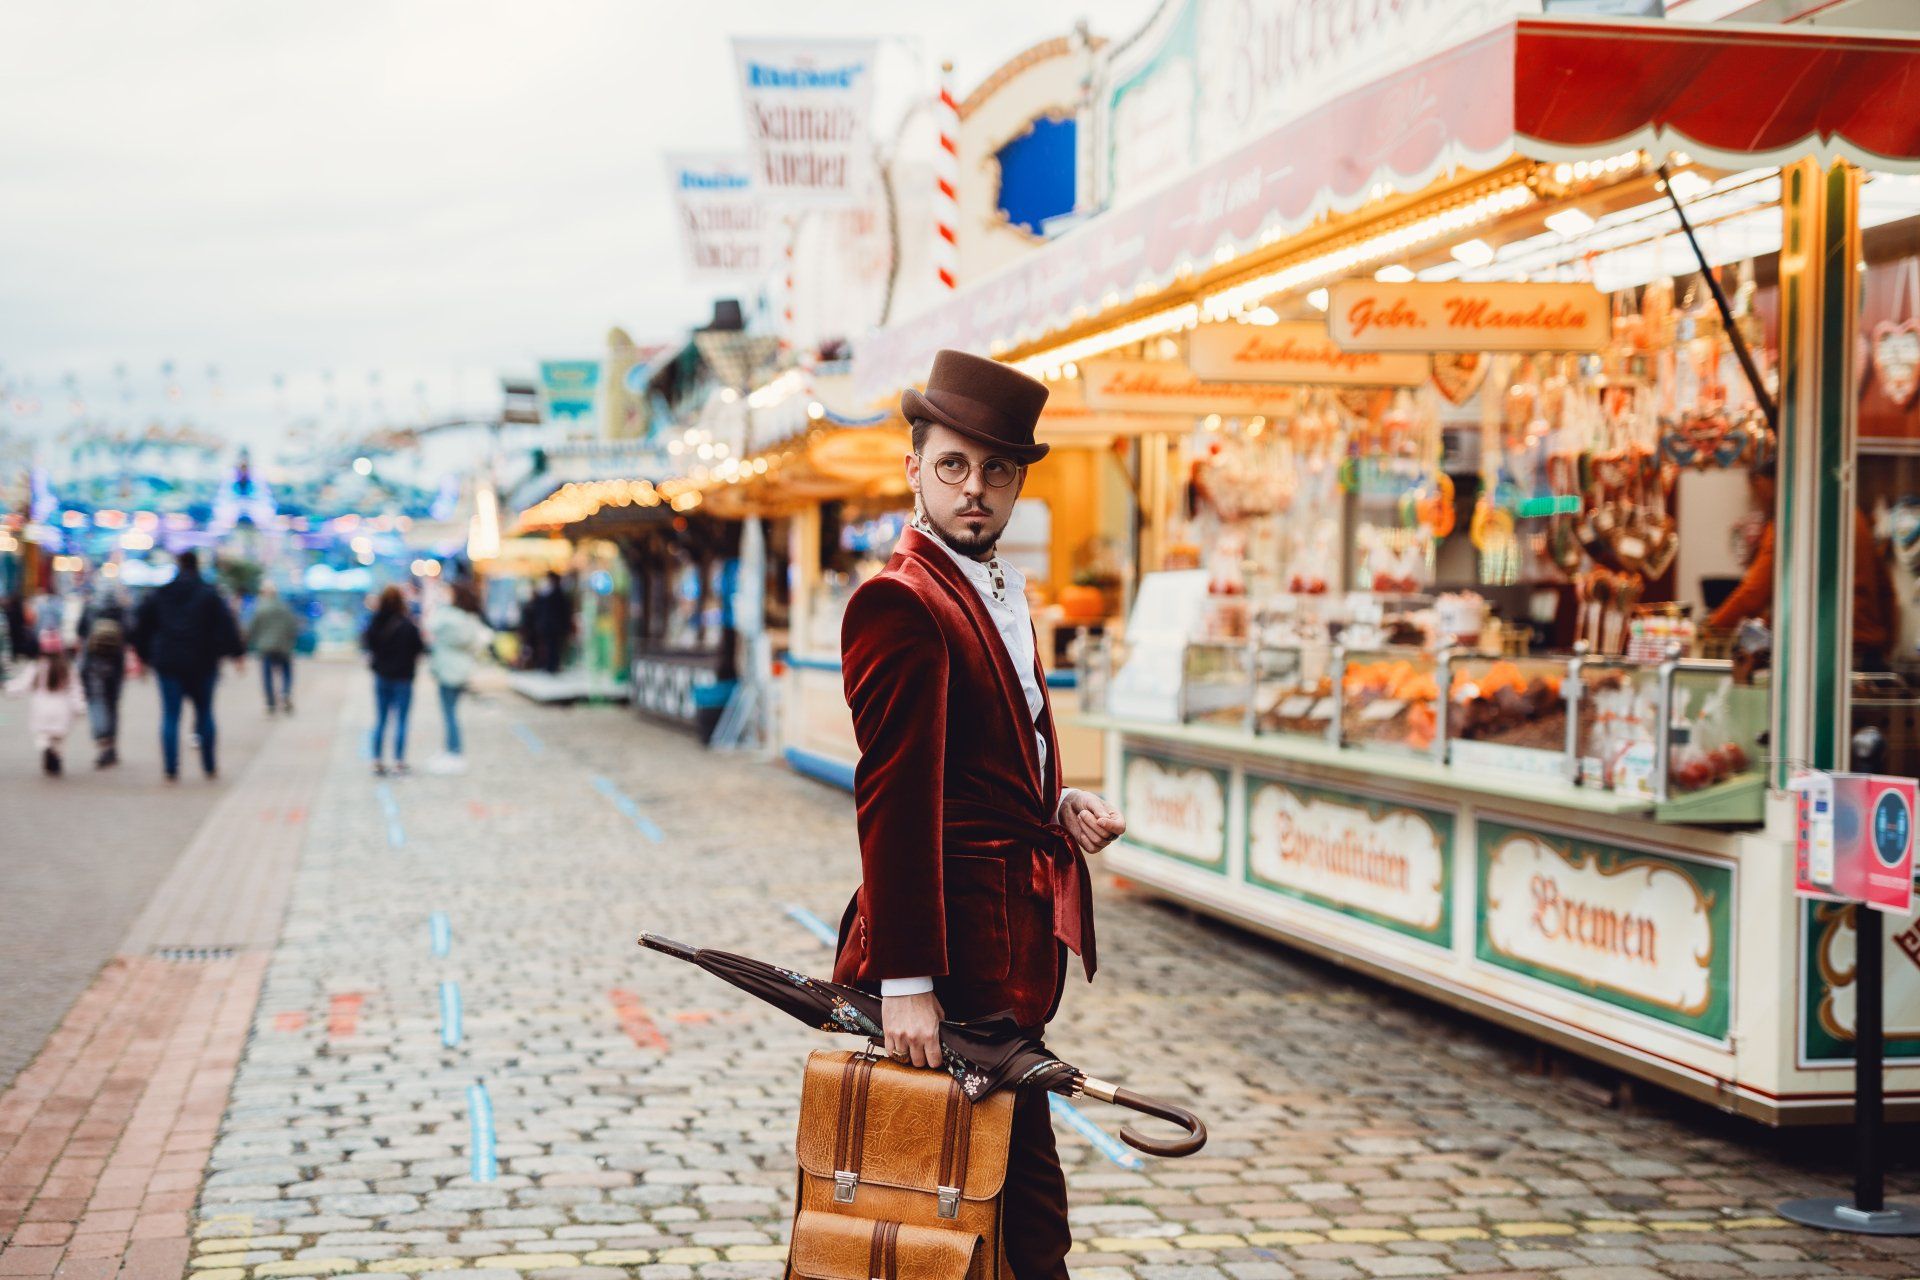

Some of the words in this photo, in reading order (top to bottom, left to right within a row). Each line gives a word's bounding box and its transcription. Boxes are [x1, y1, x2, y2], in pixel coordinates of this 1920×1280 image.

[1347, 296, 1427, 338] Gebr.
[1444, 297, 1588, 328] Mandeln
[1530, 873, 1657, 967] Bremen
